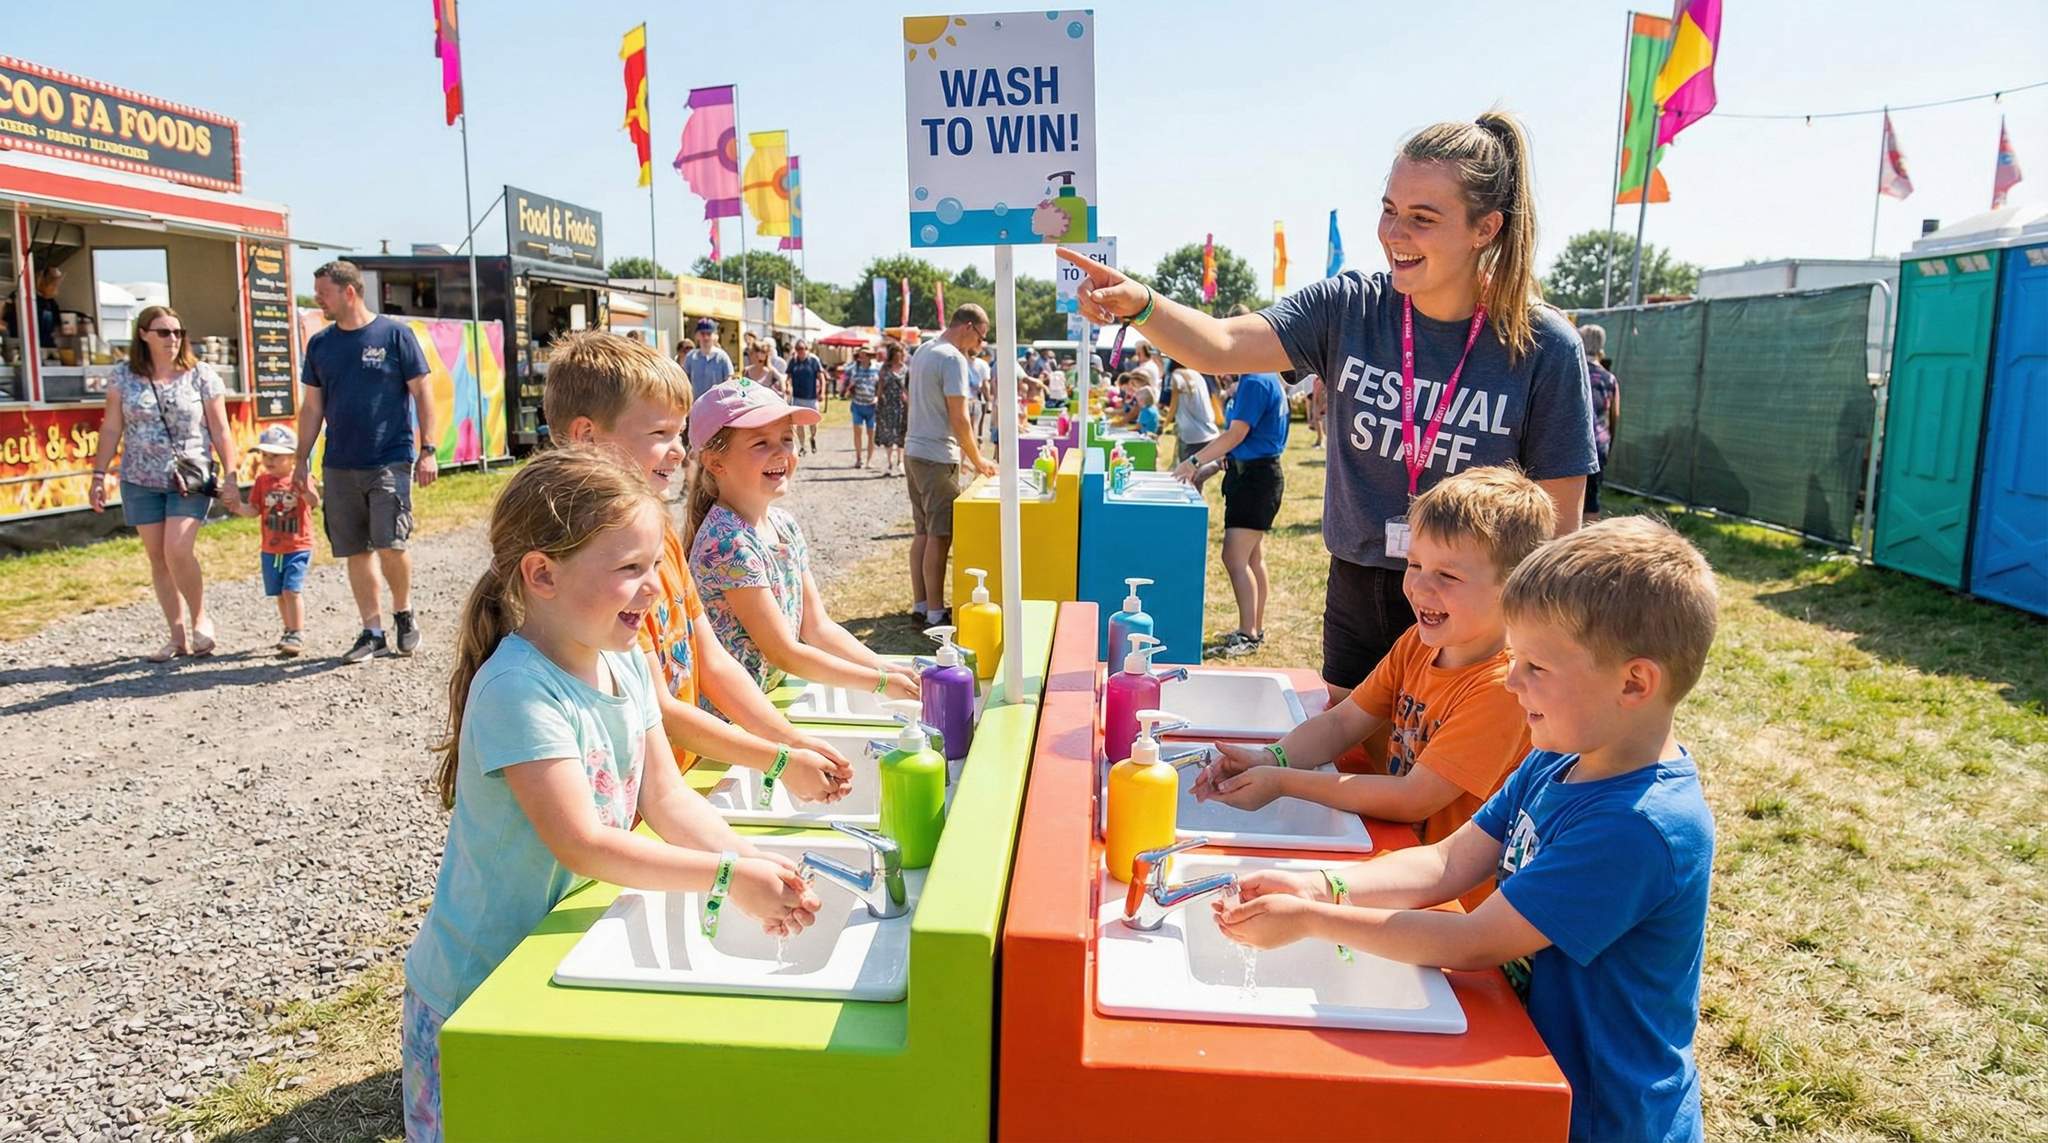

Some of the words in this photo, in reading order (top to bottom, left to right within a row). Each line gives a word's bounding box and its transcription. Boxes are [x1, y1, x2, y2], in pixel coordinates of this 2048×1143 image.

[940, 66, 1059, 108] WASH
[70, 92, 113, 135] FA
[118, 104, 212, 157] FOODS
[921, 117, 973, 156] TO
[986, 113, 1079, 154] WIN!
[518, 197, 550, 237] Food
[553, 208, 562, 240] &
[565, 210, 597, 248] Foods
[1063, 268, 1079, 281] TO
[1337, 356, 1511, 436] FESTIVAL
[1350, 411, 1477, 474] STAFF
